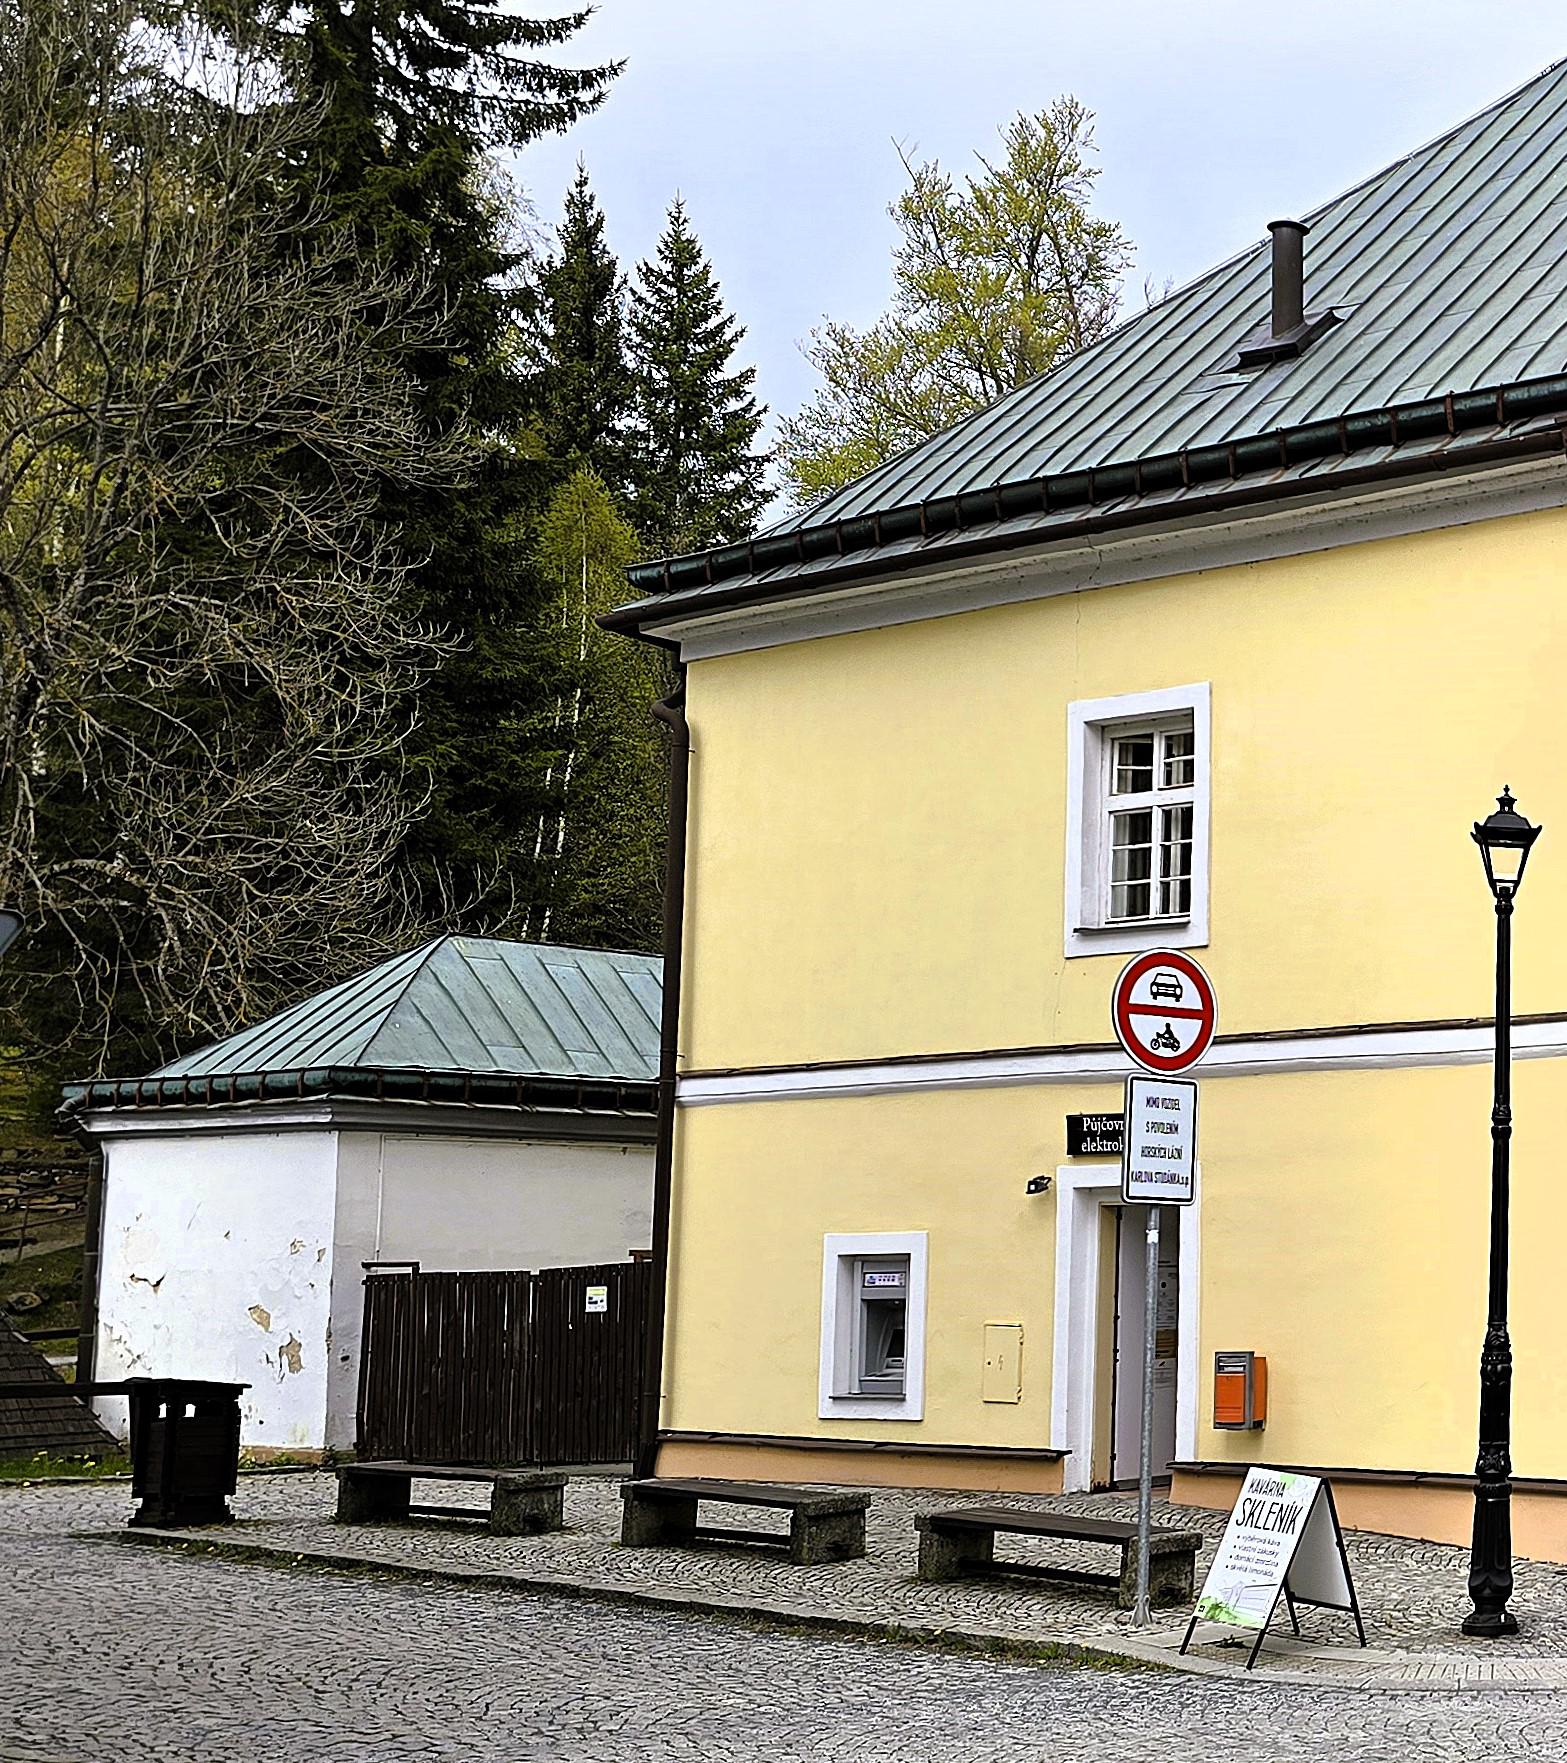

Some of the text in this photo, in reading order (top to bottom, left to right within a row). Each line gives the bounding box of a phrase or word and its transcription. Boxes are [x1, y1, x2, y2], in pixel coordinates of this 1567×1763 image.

[1145, 1121, 1151, 1133] S
[1248, 1478, 1286, 1498] KAVÁRNA
[1236, 1498, 1303, 1535] SKLENÍK
